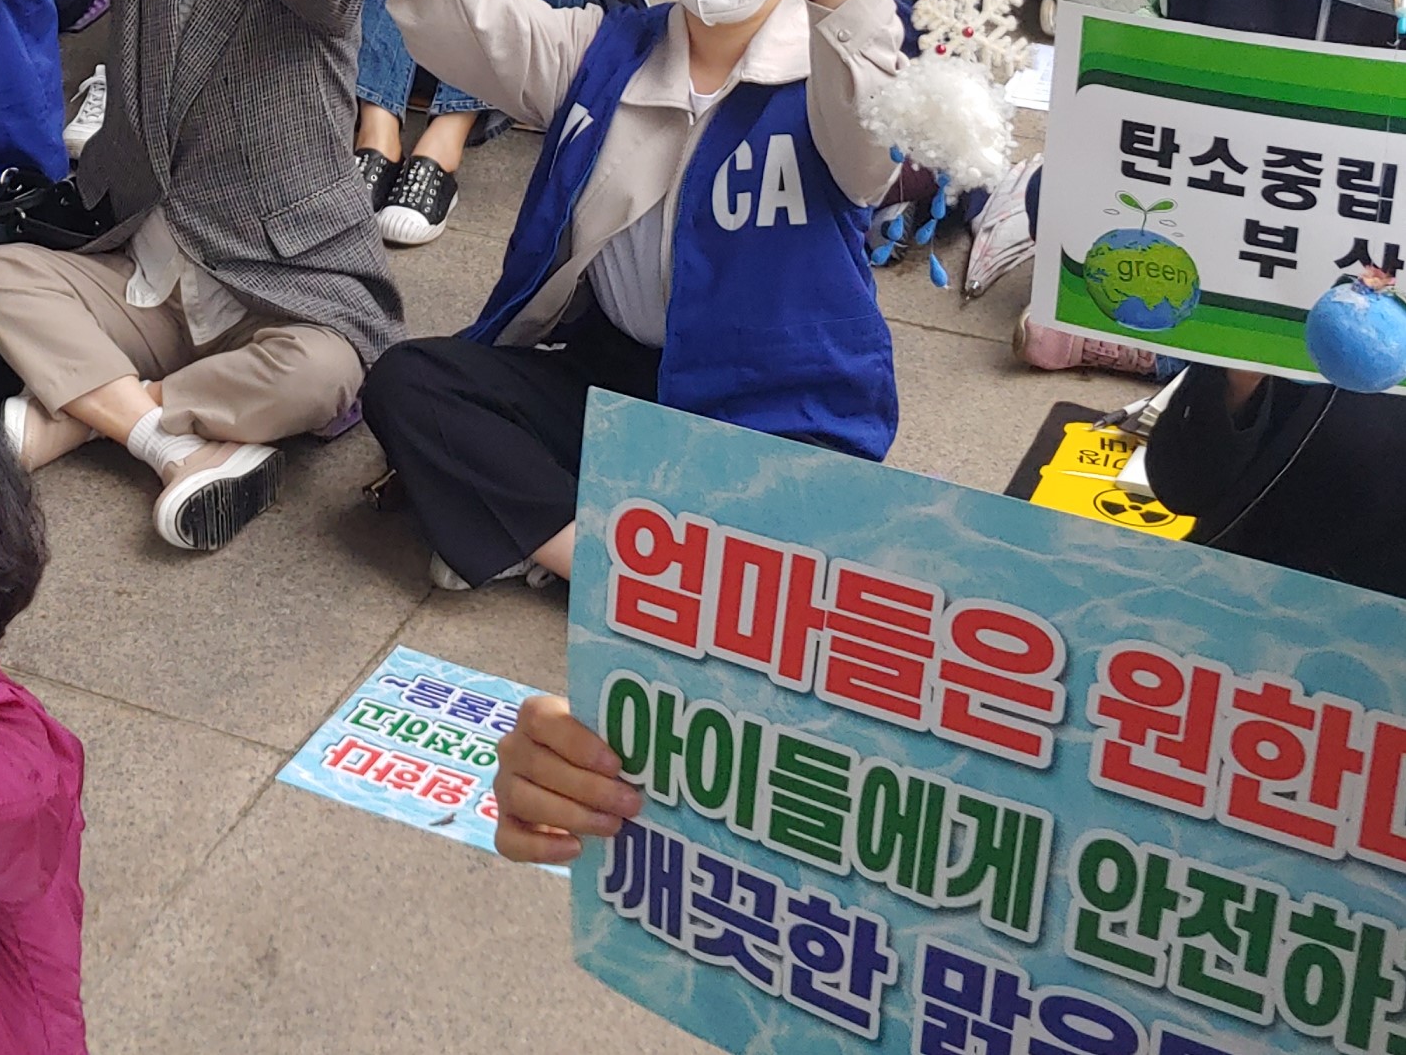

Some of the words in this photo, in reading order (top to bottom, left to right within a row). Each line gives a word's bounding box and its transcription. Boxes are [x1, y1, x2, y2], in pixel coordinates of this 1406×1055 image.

[712, 133, 808, 232] CA
[1120, 119, 1398, 225] 탄소중립
[1117, 257, 1189, 286] green
[613, 507, 1056, 759] 엄마들은
[327, 738, 477, 805] 원한다
[348, 702, 499, 767] 안전하고
[608, 681, 1043, 937] 아이들에게
[1074, 838, 1406, 1048] 안전하
[606, 831, 886, 1033] 깨끗한
